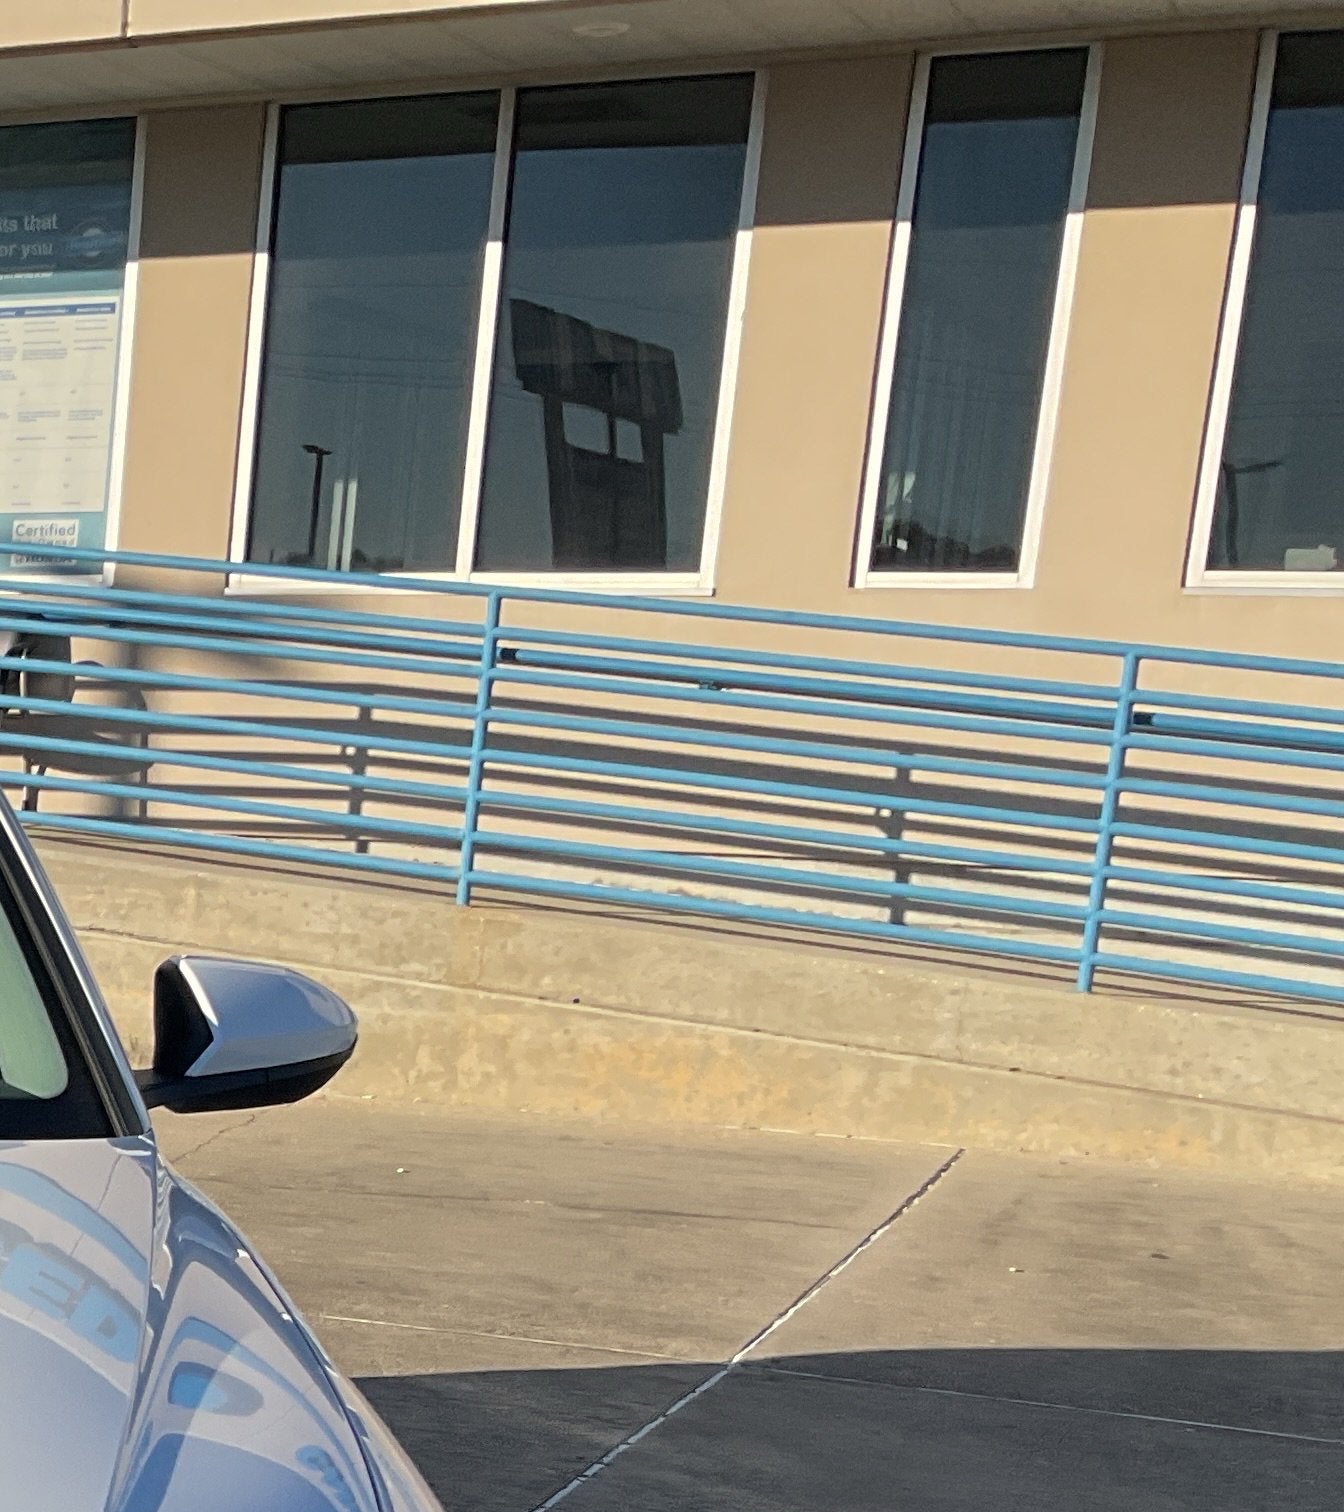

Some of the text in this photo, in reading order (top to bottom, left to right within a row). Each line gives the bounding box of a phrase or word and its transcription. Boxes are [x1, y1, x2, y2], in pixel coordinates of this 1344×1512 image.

[24, 214, 58, 232] that
[21, 243, 53, 259] you
[15, 523, 76, 538] Certified
